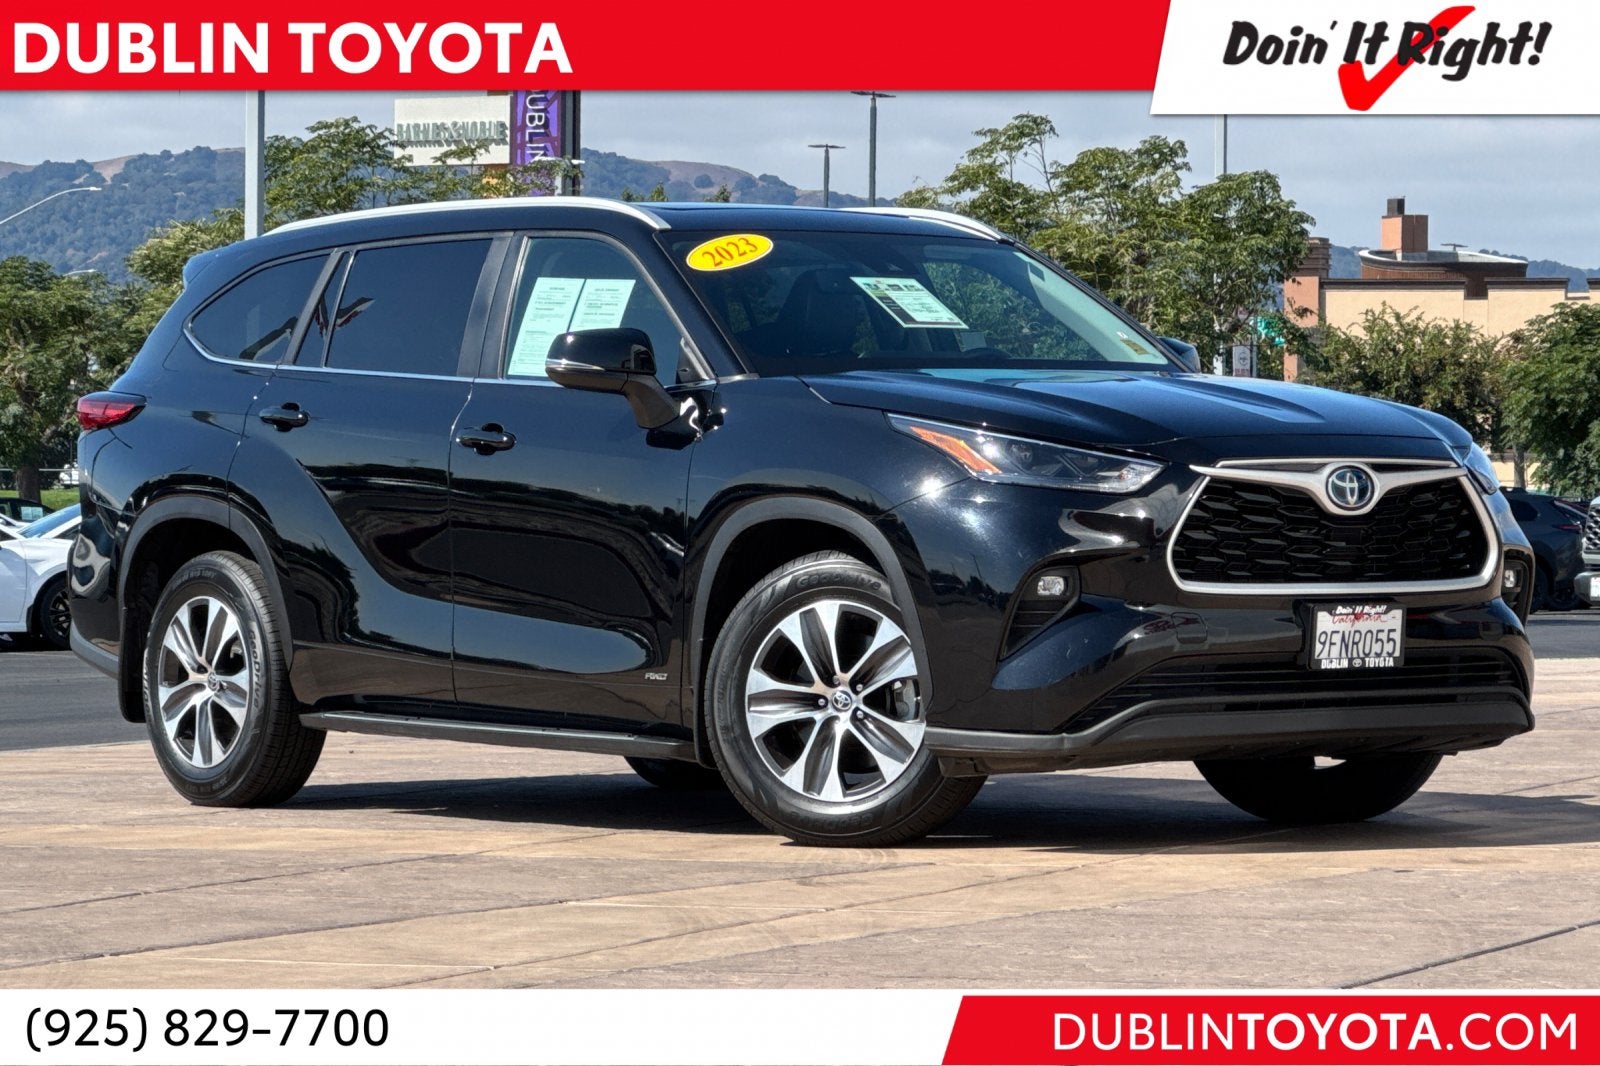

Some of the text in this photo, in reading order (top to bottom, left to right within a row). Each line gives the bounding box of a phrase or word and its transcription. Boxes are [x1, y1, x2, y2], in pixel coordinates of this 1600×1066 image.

[525, 91, 546, 163] UBLIN
[702, 237, 758, 267] 2023
[1316, 628, 1397, 658] 9FNR055
[1364, 657, 1395, 668] TOYOTA
